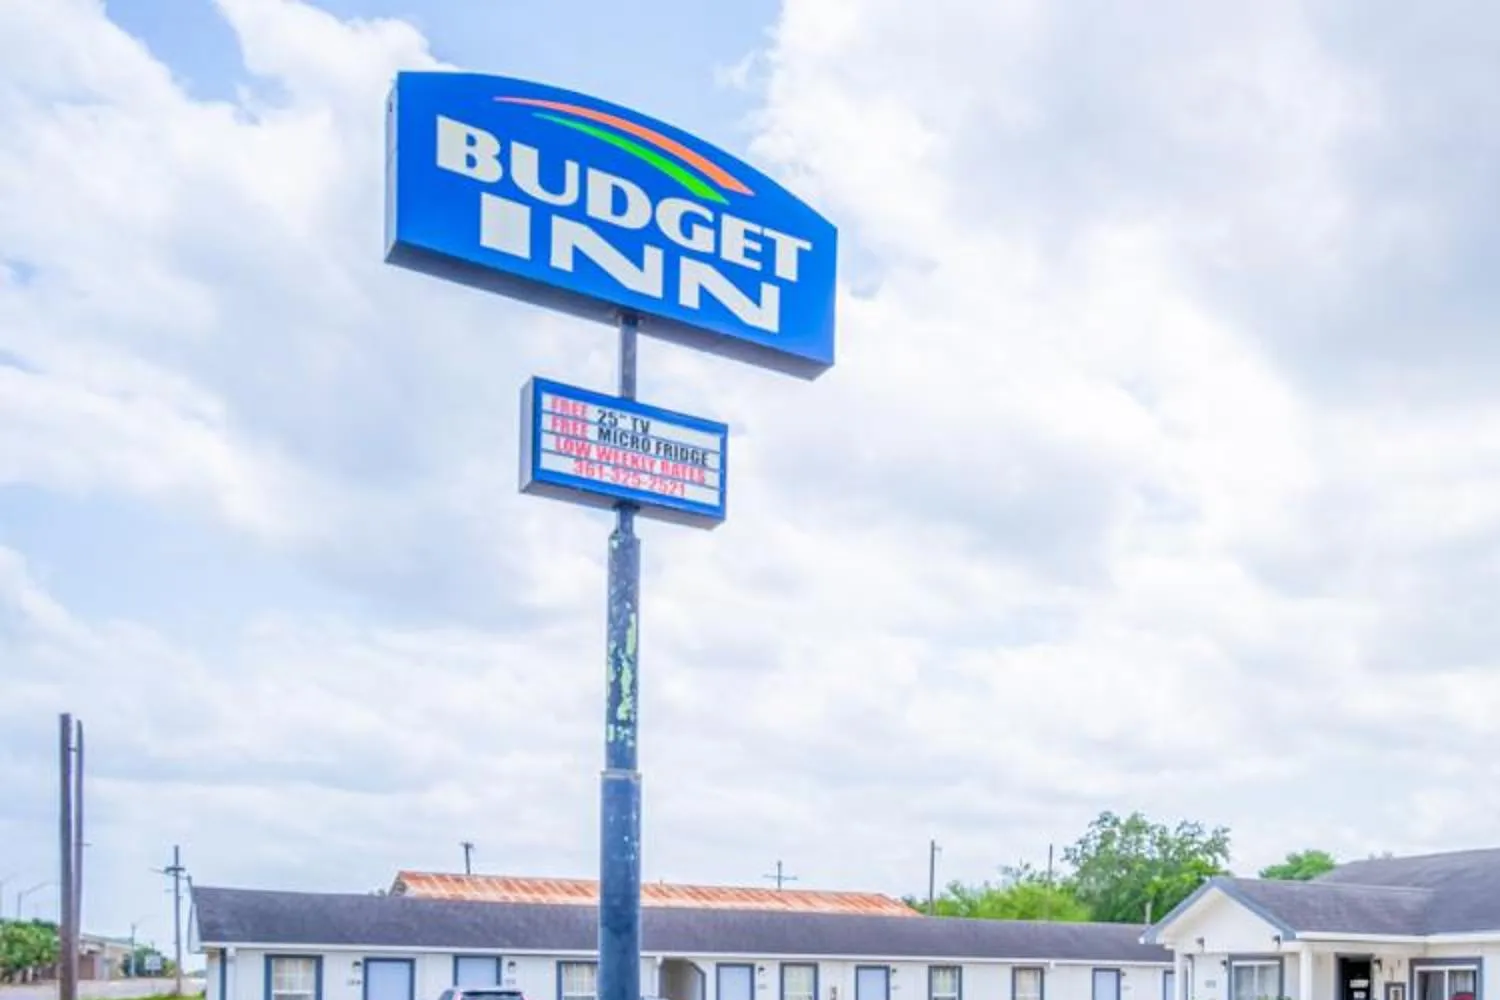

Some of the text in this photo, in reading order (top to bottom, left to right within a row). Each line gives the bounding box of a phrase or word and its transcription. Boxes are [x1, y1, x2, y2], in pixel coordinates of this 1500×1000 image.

[436, 114, 813, 282] BUDGET
[479, 192, 780, 334] INN
[551, 397, 588, 416] FREE
[632, 416, 651, 435] TV
[551, 416, 708, 466] FREE MICRO FRIDGE
[555, 436, 591, 458] LOW
[596, 445, 656, 473] WEEKLY
